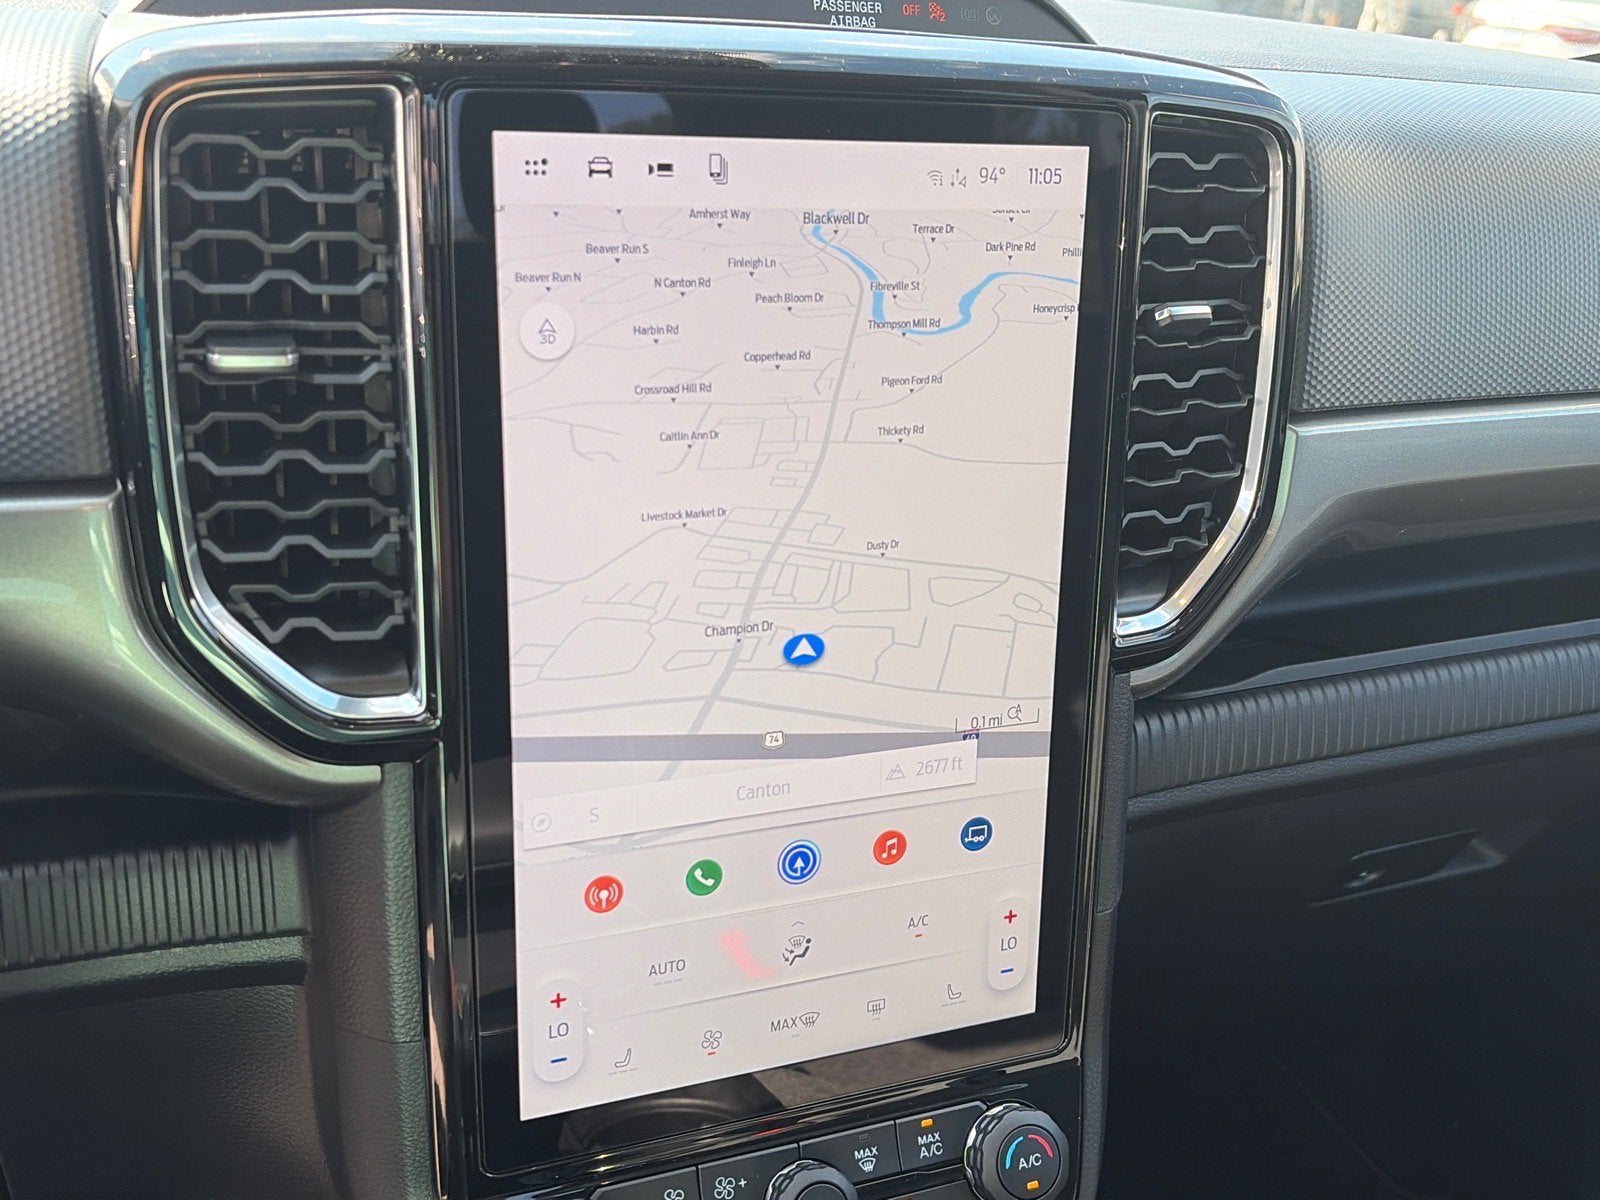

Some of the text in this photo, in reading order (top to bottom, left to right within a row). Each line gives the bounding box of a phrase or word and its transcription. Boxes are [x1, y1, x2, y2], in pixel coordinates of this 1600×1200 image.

[813, 0, 882, 14] PASSENGER
[903, 4, 921, 16] OFF
[829, 15, 876, 28] AIRBAG
[1028, 167, 1062, 185] 11:05
[689, 209, 751, 221] Amherst Way
[803, 212, 870, 225] Blackwell Dr
[913, 224, 955, 234] Terrace Dr
[585, 243, 649, 254] Beaver Run S
[985, 242, 1036, 252] Dark Pine Rd
[728, 257, 776, 270] Finleigh Ln
[515, 272, 582, 283] Beaver Run N
[654, 277, 711, 288] N Canton Rd
[870, 281, 920, 291] Fibreville St
[755, 292, 824, 303] Peach Bloom Dr
[1033, 304, 1075, 316] Honeycrisp
[633, 324, 680, 335] Harbin Rd
[868, 318, 941, 330] Thompson Mill Rd
[540, 334, 556, 345] 3D
[744, 350, 811, 364] Copperhead Rd
[881, 374, 943, 387] Pigeon Ford Rd
[634, 382, 712, 396] Crossroad Hill Rd
[659, 430, 720, 442] Caitlin Ann Dr
[878, 424, 924, 439] Thickety Rd
[641, 507, 727, 522] Livestock Market Dr
[866, 539, 900, 553] Dusty Dr
[704, 620, 774, 640] Champion Dr
[970, 713, 1003, 729] 0.1 mi
[768, 734, 780, 745] 74
[915, 757, 963, 777] 2677 ft
[736, 782, 791, 801] Canton
[589, 807, 600, 823] S
[907, 914, 929, 930] A/C
[1000, 936, 1018, 952] LO
[648, 958, 686, 977] AUTO
[548, 1022, 569, 1040] LO
[770, 1016, 798, 1033] MAX
[917, 1131, 941, 1146] MAX
[854, 1145, 878, 1160] MAX
[919, 1145, 944, 1160] A/C
[1018, 1153, 1042, 1170] A/C
